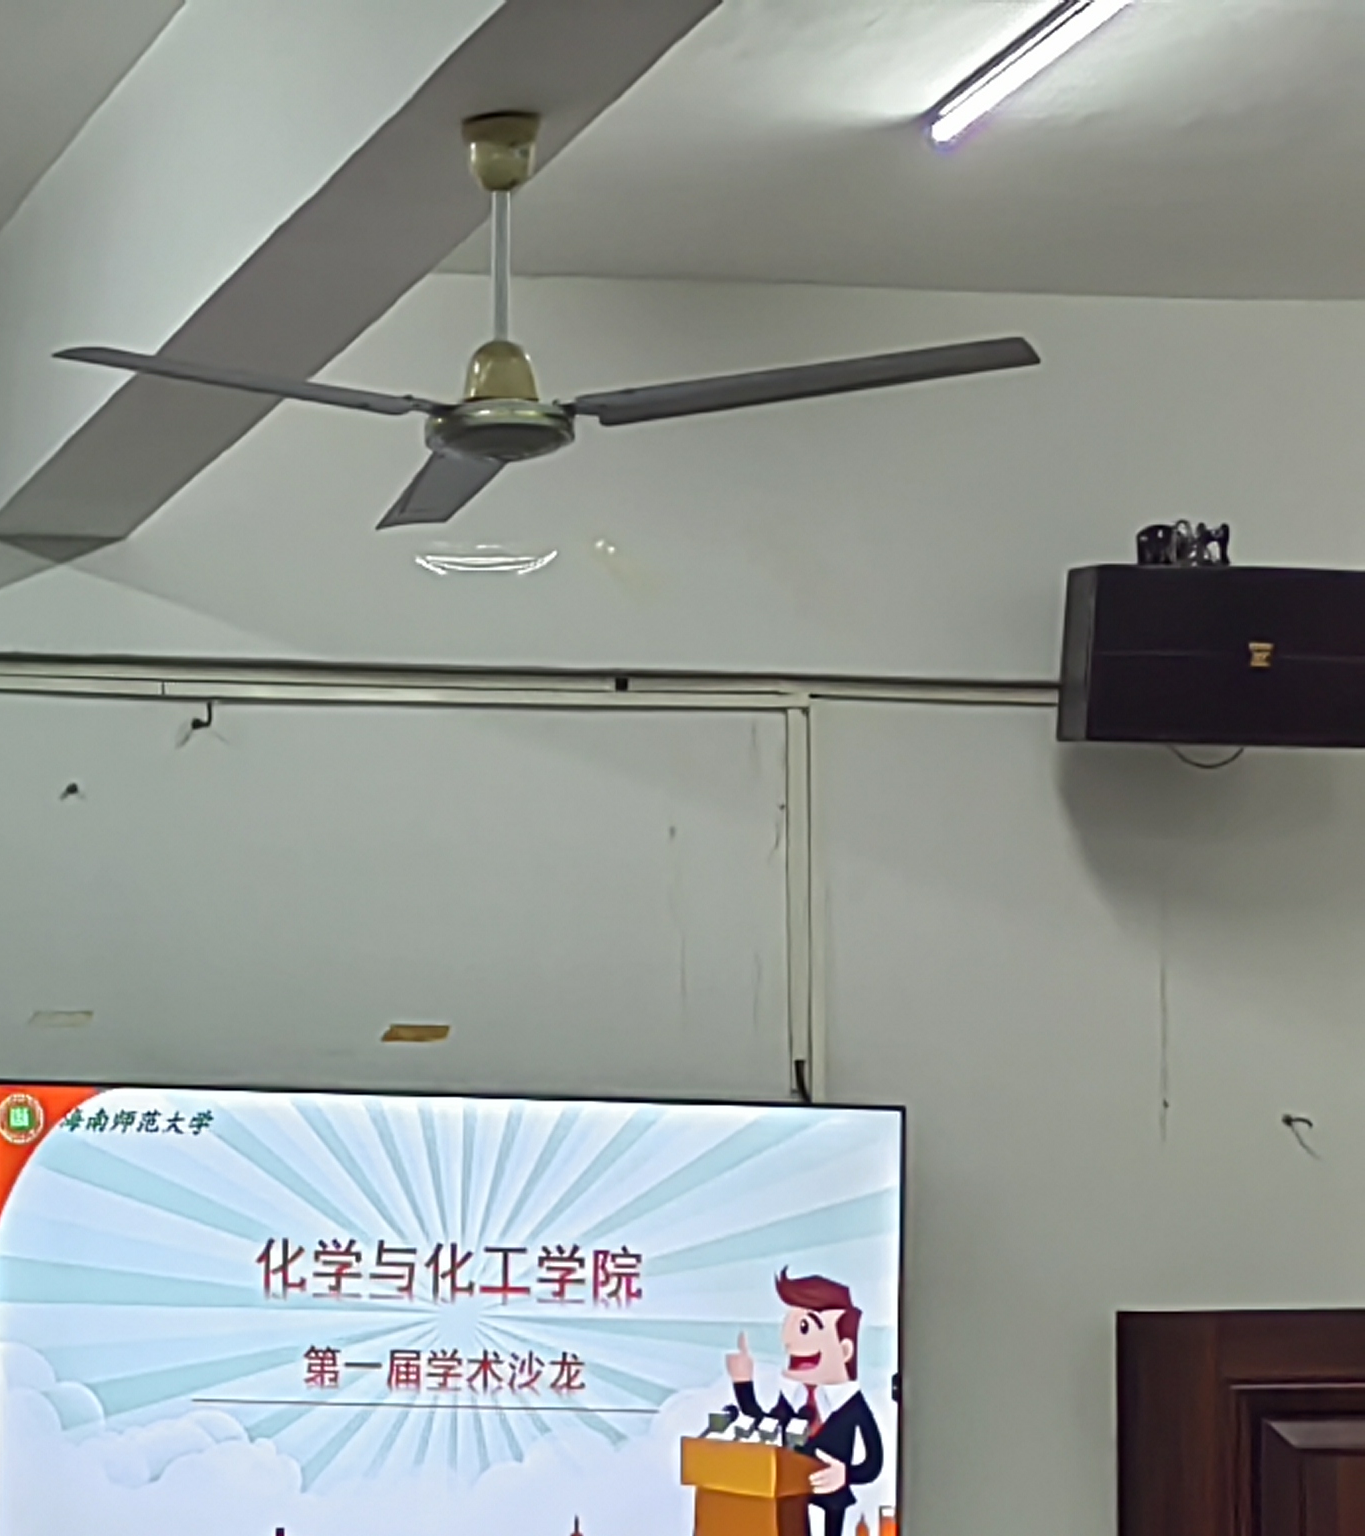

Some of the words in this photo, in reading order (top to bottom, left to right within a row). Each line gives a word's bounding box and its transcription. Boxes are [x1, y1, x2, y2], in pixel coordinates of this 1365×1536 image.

[256, 1238, 643, 1300] 化学与化工学院
[303, 1345, 586, 1390] 第一届学术沙龙
